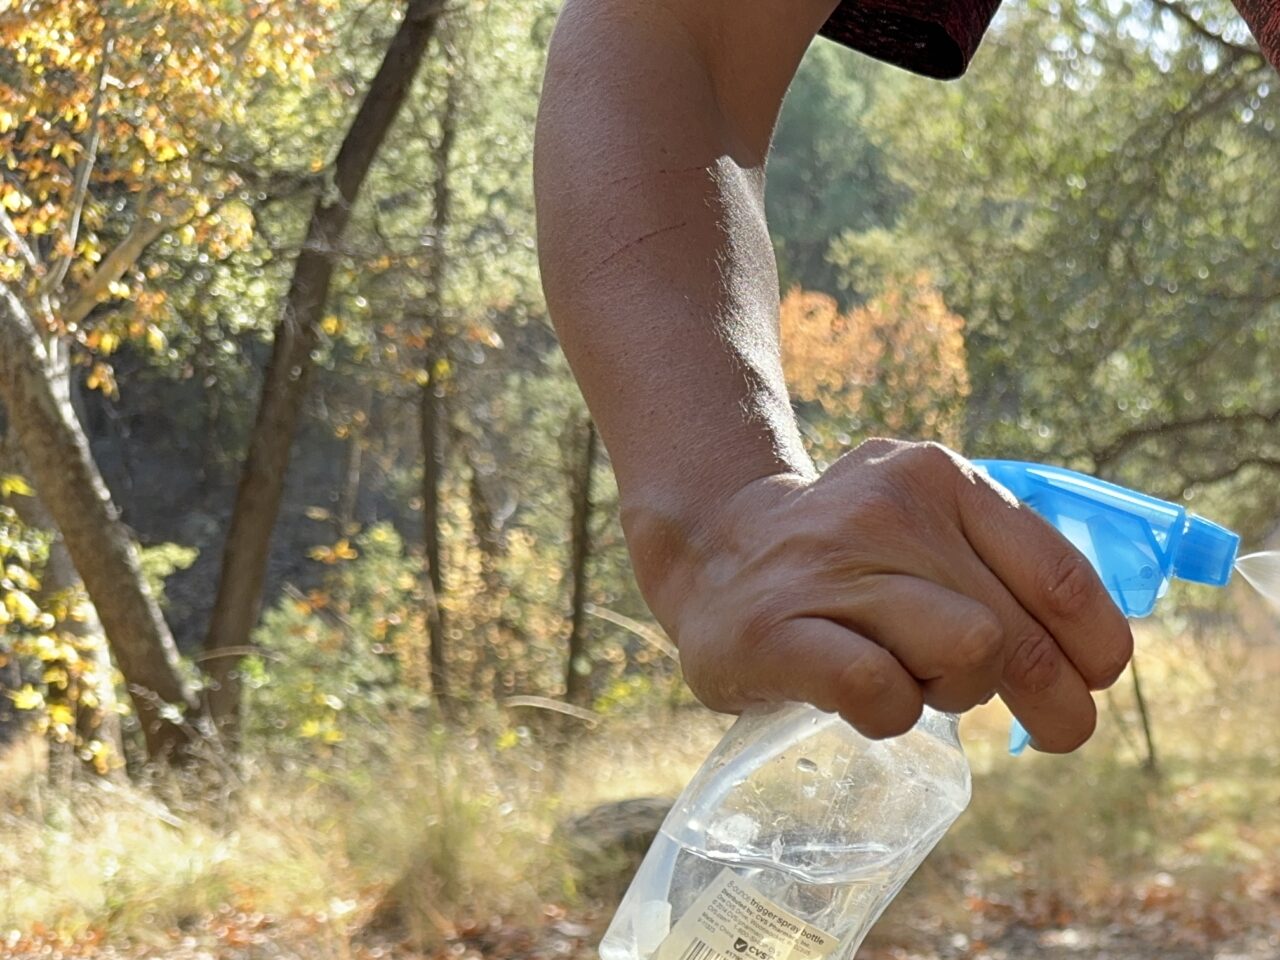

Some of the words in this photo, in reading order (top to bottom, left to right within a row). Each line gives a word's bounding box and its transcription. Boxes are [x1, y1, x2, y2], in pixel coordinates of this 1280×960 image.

[750, 898, 777, 921] trigger
[778, 917, 800, 934] spray
[800, 928, 825, 946] bottle
[755, 914, 768, 926] CVS
[748, 944, 768, 960] CVS
